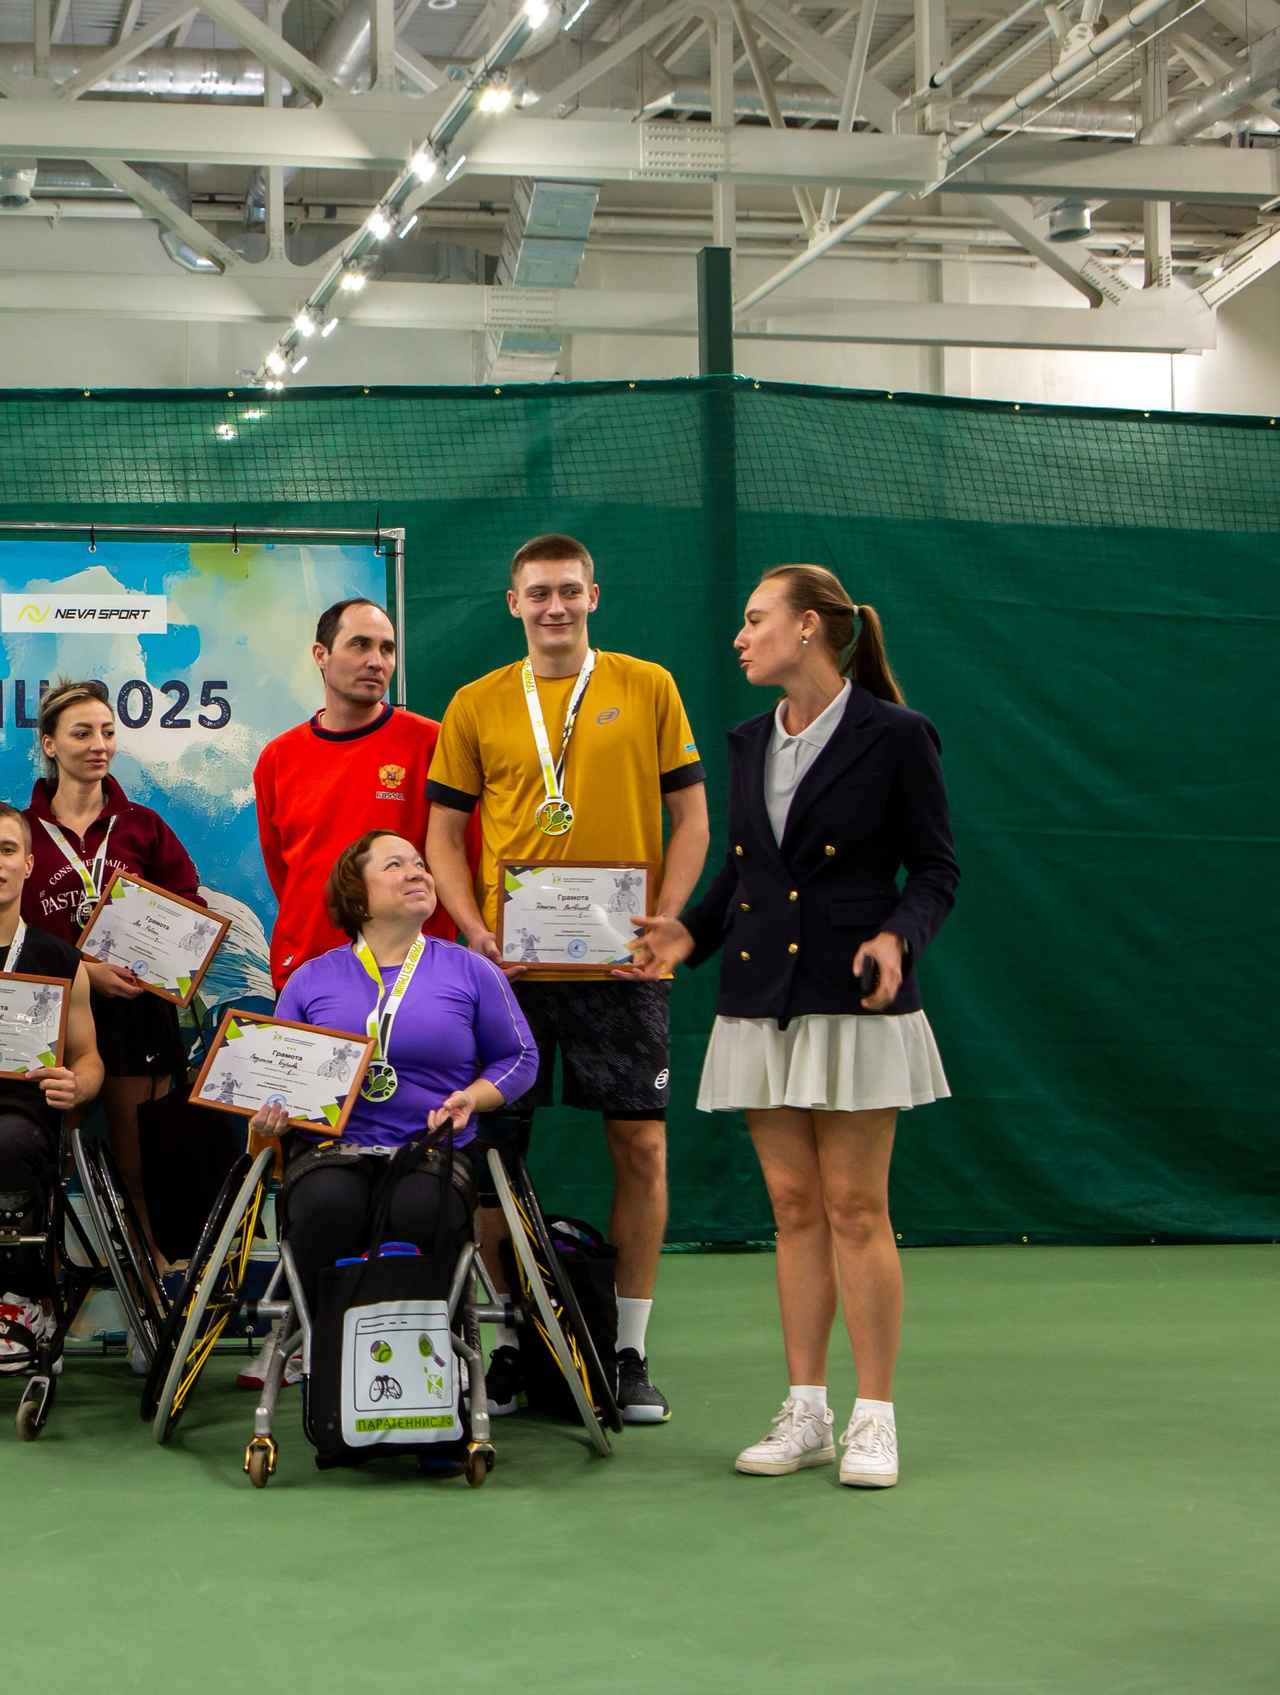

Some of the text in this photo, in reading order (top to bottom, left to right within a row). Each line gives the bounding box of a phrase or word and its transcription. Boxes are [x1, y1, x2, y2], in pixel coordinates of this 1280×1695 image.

[54, 608, 151, 620] NEVA SPORT
[90, 679, 232, 730] 025
[557, 894, 590, 902] Грамота
[145, 915, 170, 932] Грамота
[272, 1049, 303, 1062] Грамота
[357, 1415, 455, 1432] ПАРАТЕННИС.РФ
